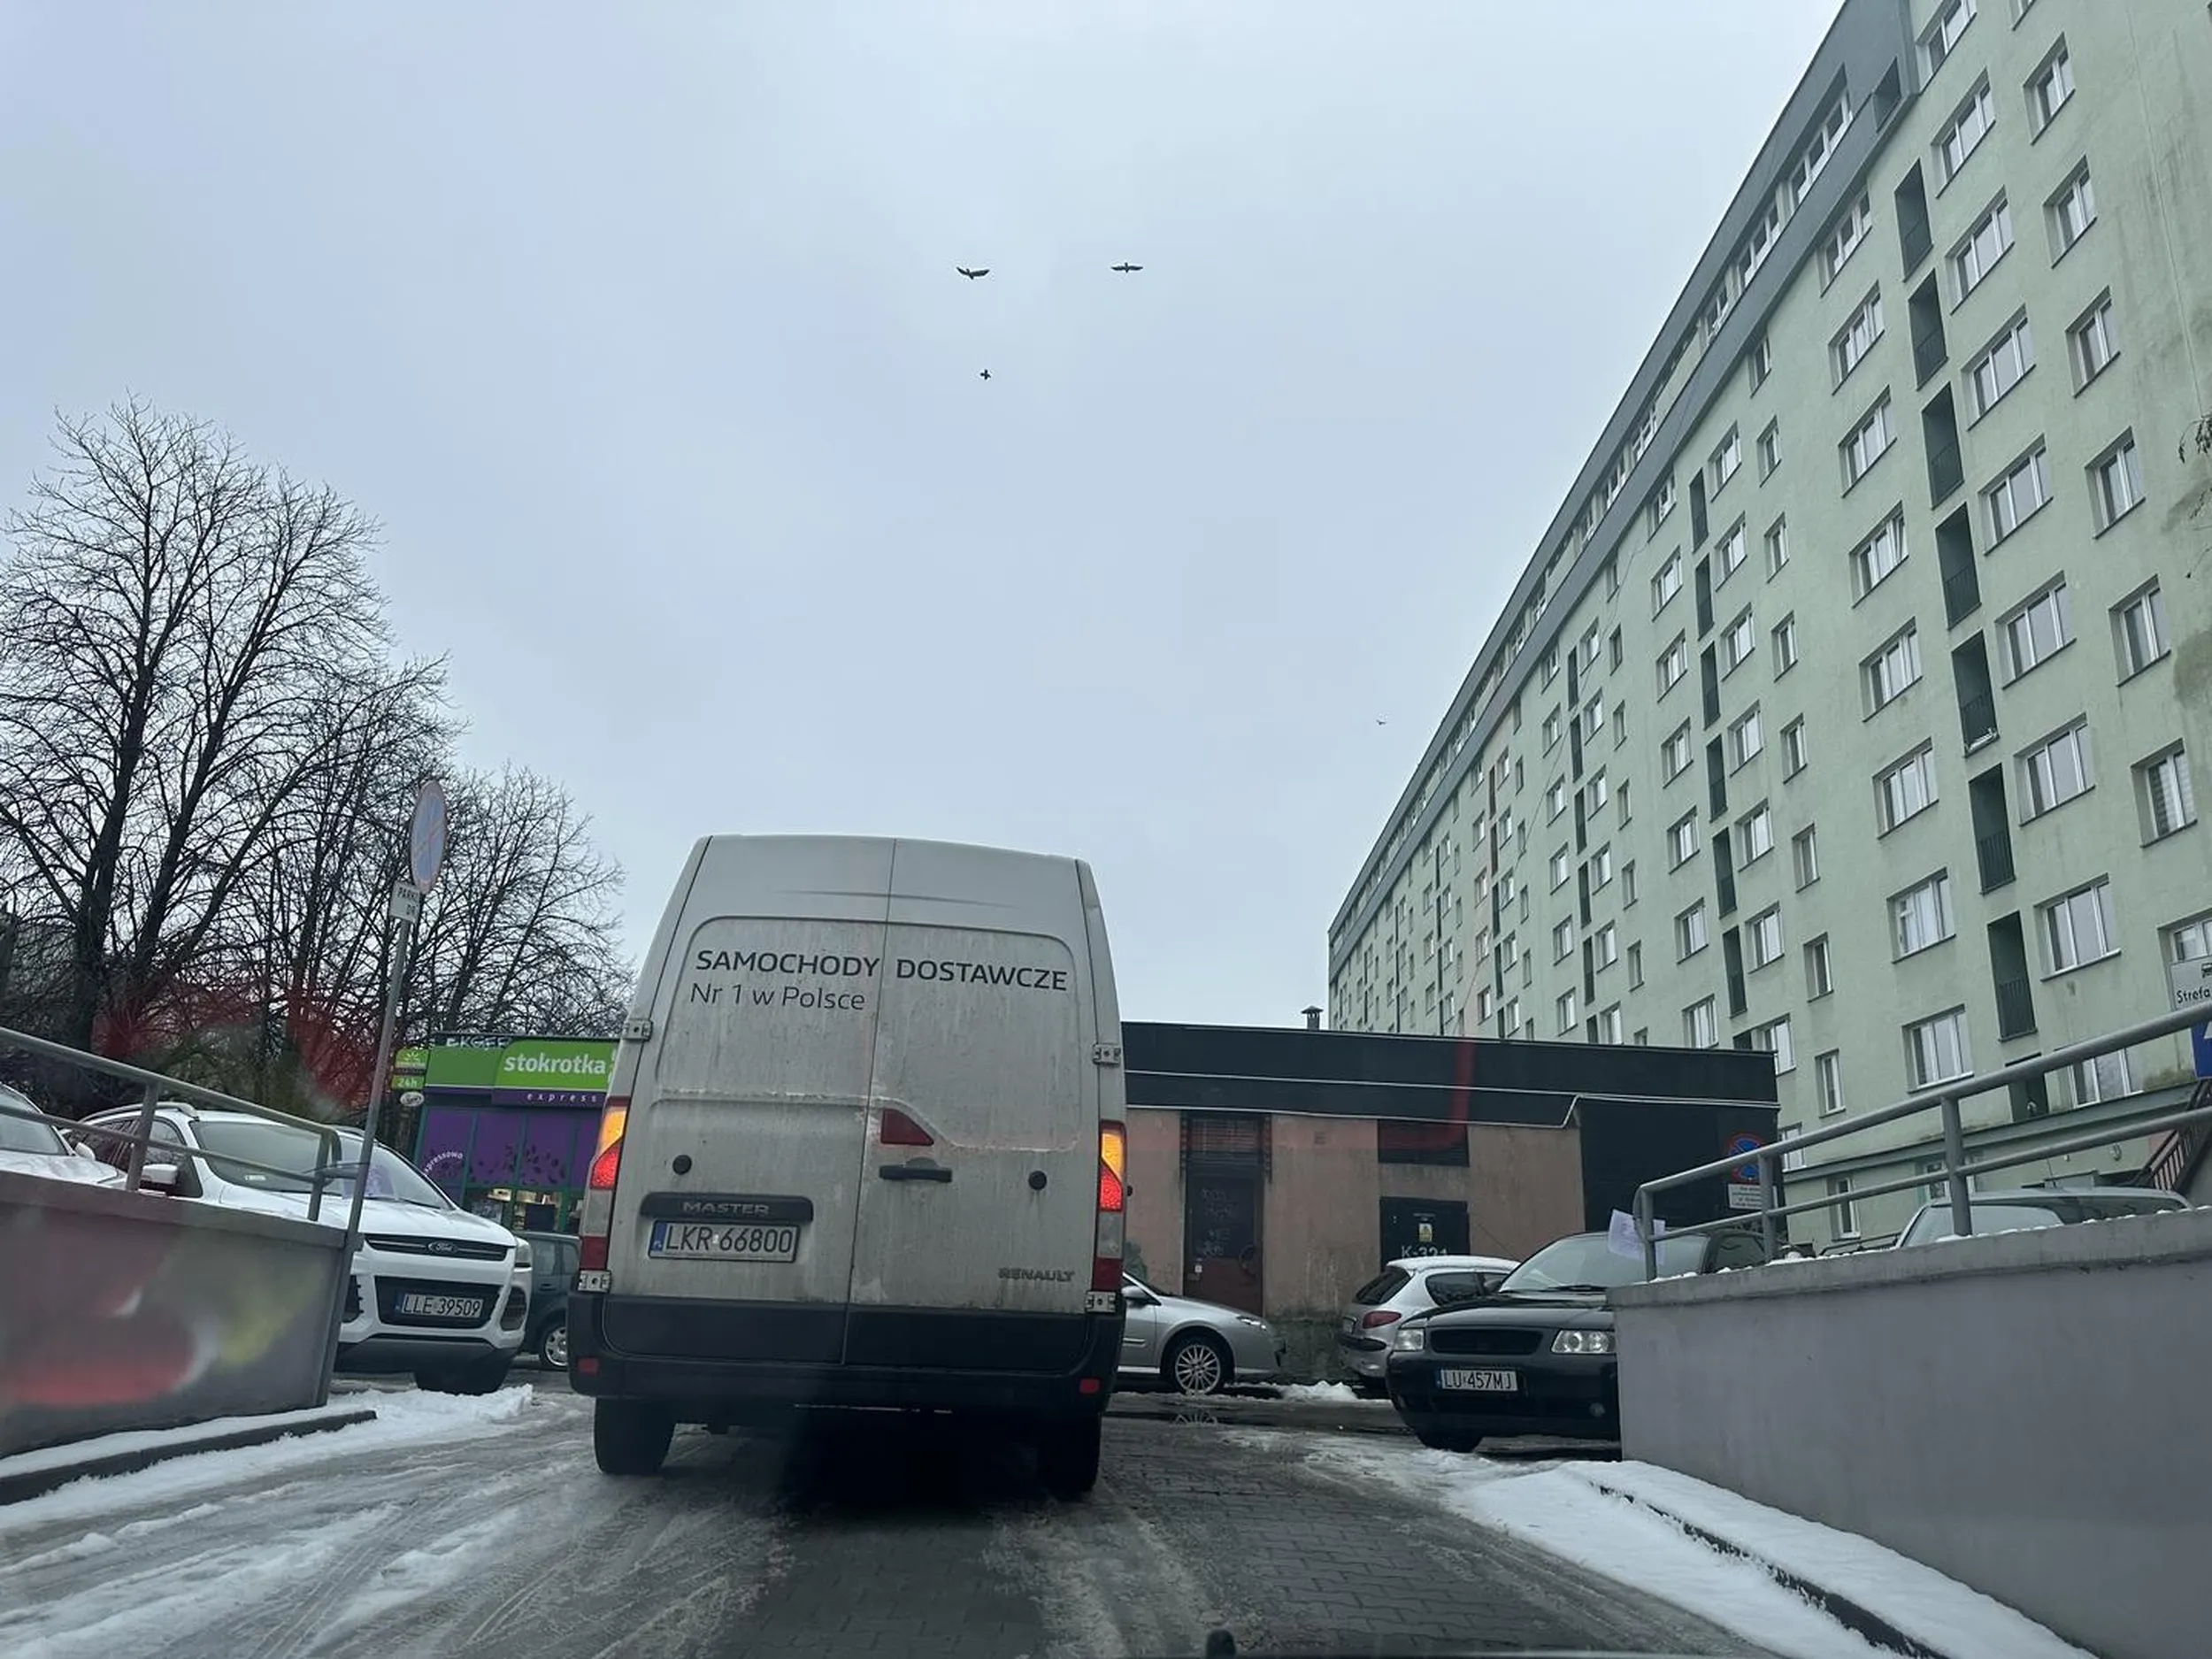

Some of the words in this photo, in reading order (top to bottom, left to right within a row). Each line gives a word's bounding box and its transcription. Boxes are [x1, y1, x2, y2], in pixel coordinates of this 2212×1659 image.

[695, 950, 880, 977] SAMOCHODY
[896, 958, 1067, 991] DOSTAWCZE
[690, 982, 723, 1004] Nr
[732, 984, 741, 1003] 1
[752, 989, 775, 1005] w
[782, 986, 865, 1010] Polsce
[2177, 987, 2211, 1003] Strefa
[503, 1052, 606, 1074] stokrotka
[526, 1093, 597, 1102] express
[682, 1202, 770, 1216] MASTER
[665, 1226, 713, 1252] LKR
[718, 1228, 794, 1254] 66800
[997, 1267, 1076, 1283] RENAULT
[403, 1295, 433, 1314] LLE
[436, 1297, 481, 1317] 39509
[1444, 1371, 1463, 1389] LU
[1466, 1371, 1512, 1390] 457MJ
